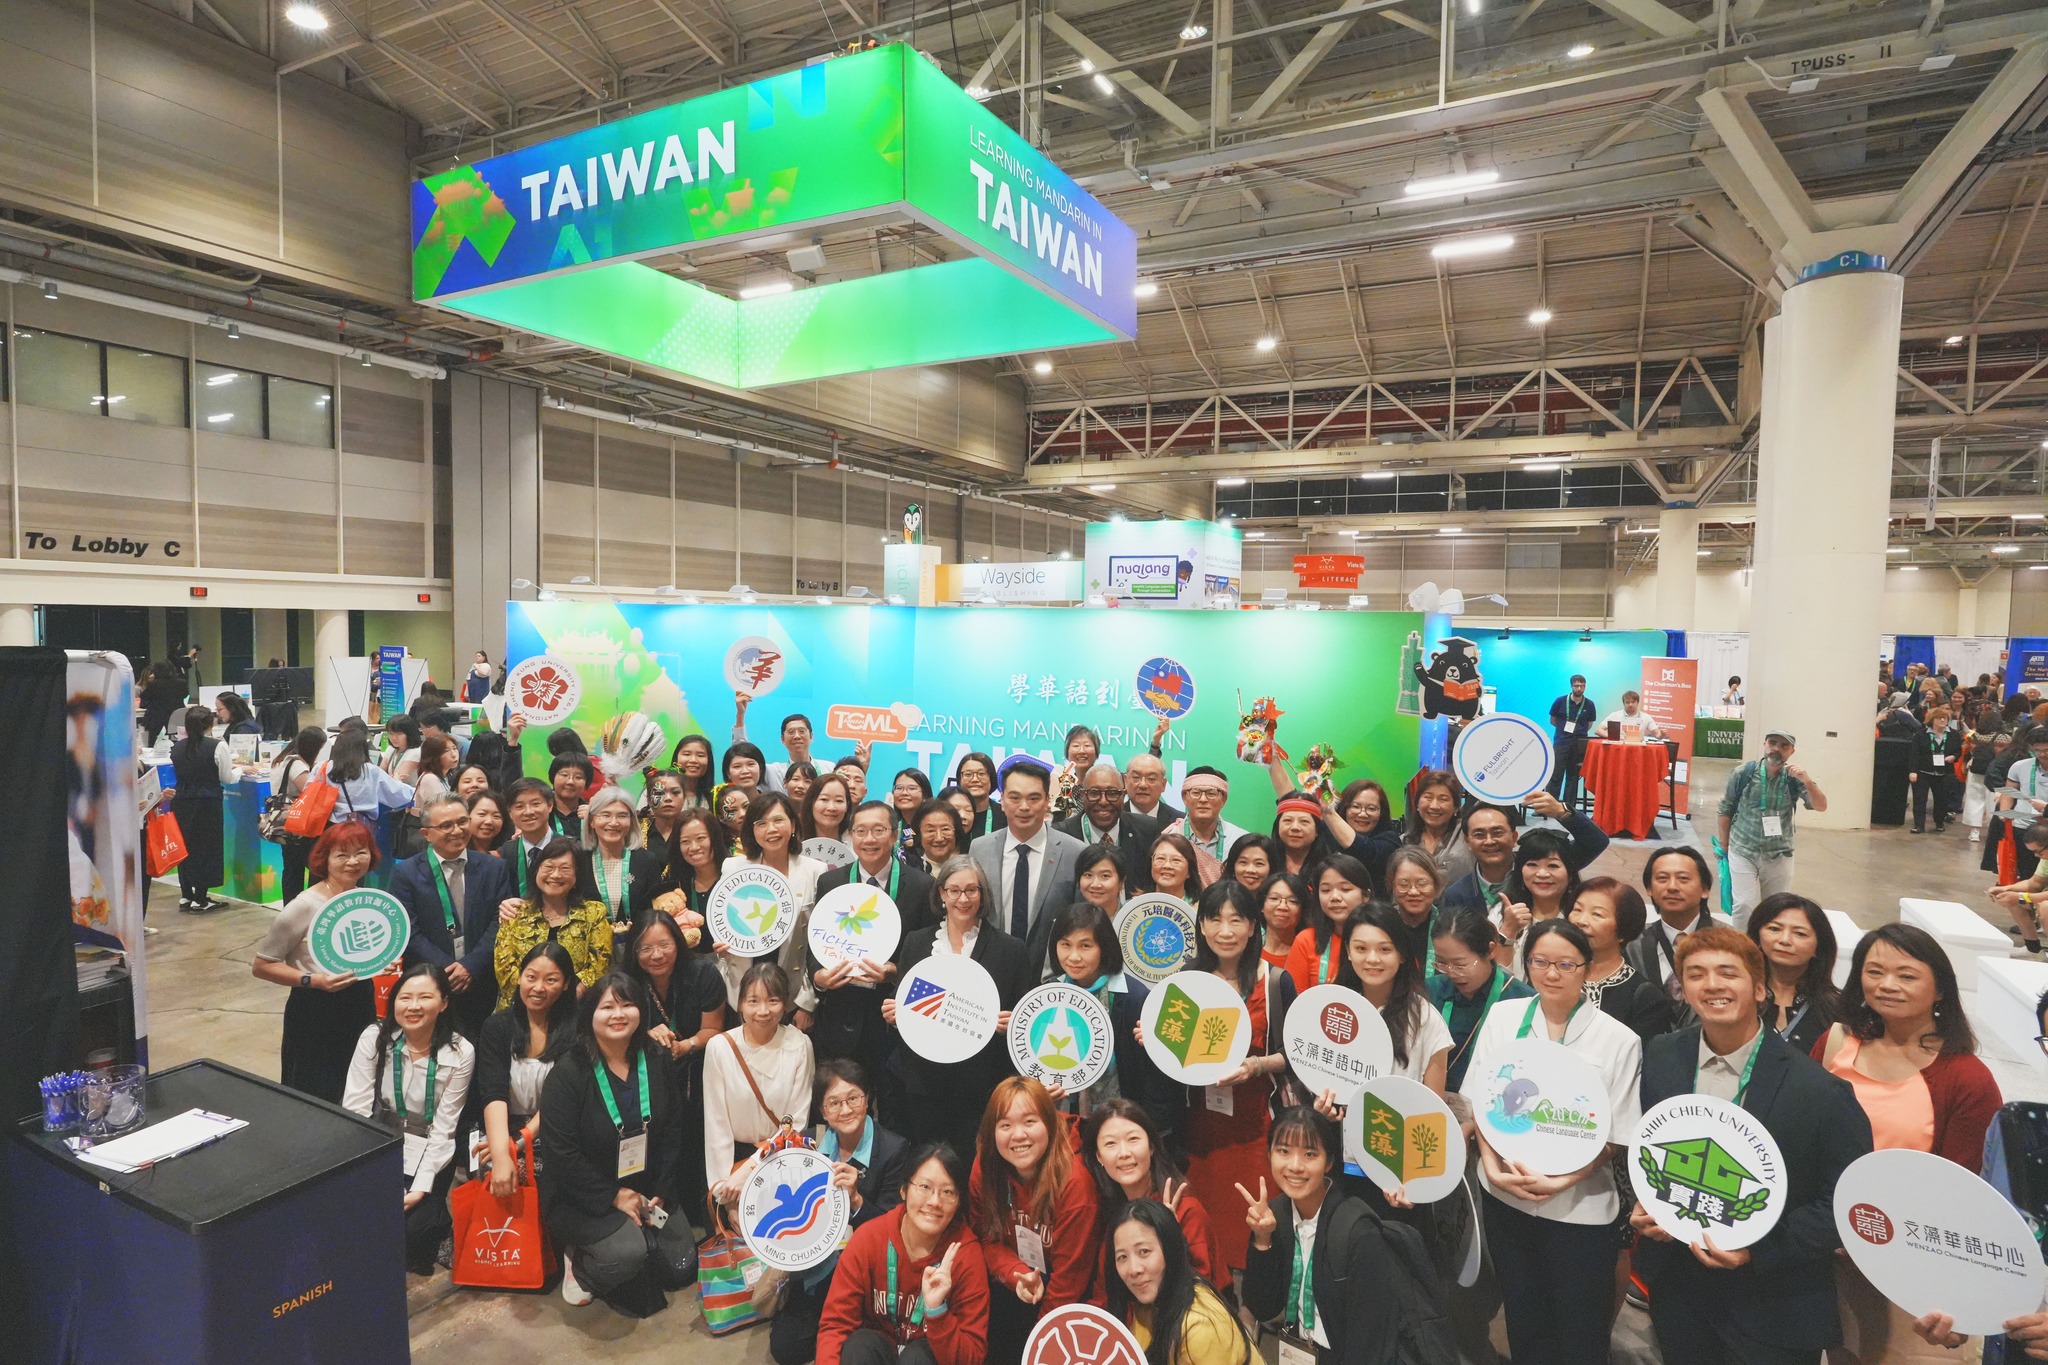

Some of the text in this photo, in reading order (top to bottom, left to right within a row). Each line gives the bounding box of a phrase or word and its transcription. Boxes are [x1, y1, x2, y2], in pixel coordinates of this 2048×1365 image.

[521, 120, 735, 222] TAIWAN
[970, 124, 1102, 242] LEARNING MANDARIN IN
[970, 158, 1103, 297] TAIWAN
[25, 532, 181, 558] To Lobby C
[981, 567, 1046, 588] Wayside
[509, 661, 559, 721] NATIONAL CHENG KUNG
[541, 660, 576, 688] UNIVERSITY
[834, 710, 898, 734] TCML
[1483, 738, 1515, 772] FULBRIGHT
[1488, 757, 1509, 777] Taiwan
[725, 872, 787, 898] EDUCATION
[713, 891, 756, 950] MINISTRY OF
[761, 901, 792, 948] 教育部
[812, 928, 869, 958] FICHET
[944, 1008, 970, 1025] TAIWAN
[947, 1001, 980, 1020] INSTITUTE
[948, 992, 985, 1012] AMERICAN
[1015, 991, 1105, 1071] MINISTRY OF EDUCATION
[1028, 1062, 1087, 1088] 教育部
[1290, 1056, 1360, 1086] WENZAO Chinese Language
[1292, 1037, 1378, 1080] 文藻華語中心
[1370, 1107, 1399, 1158] 文藻
[1536, 1123, 1555, 1134] Chinese
[1556, 1127, 1579, 1138] Language
[1580, 1130, 1597, 1140] Center
[1641, 1105, 1777, 1184] SHIH CHIEN UNIVERSITY
[763, 1188, 842, 1262] MING CHUAN UNIVERSITY
[474, 1247, 520, 1262] VISTA
[1903, 1219, 2026, 1268] 文藻華語中心
[1906, 1241, 2028, 1278] WENZAO Chinese Language Center
[272, 1280, 333, 1319] SPANISH
